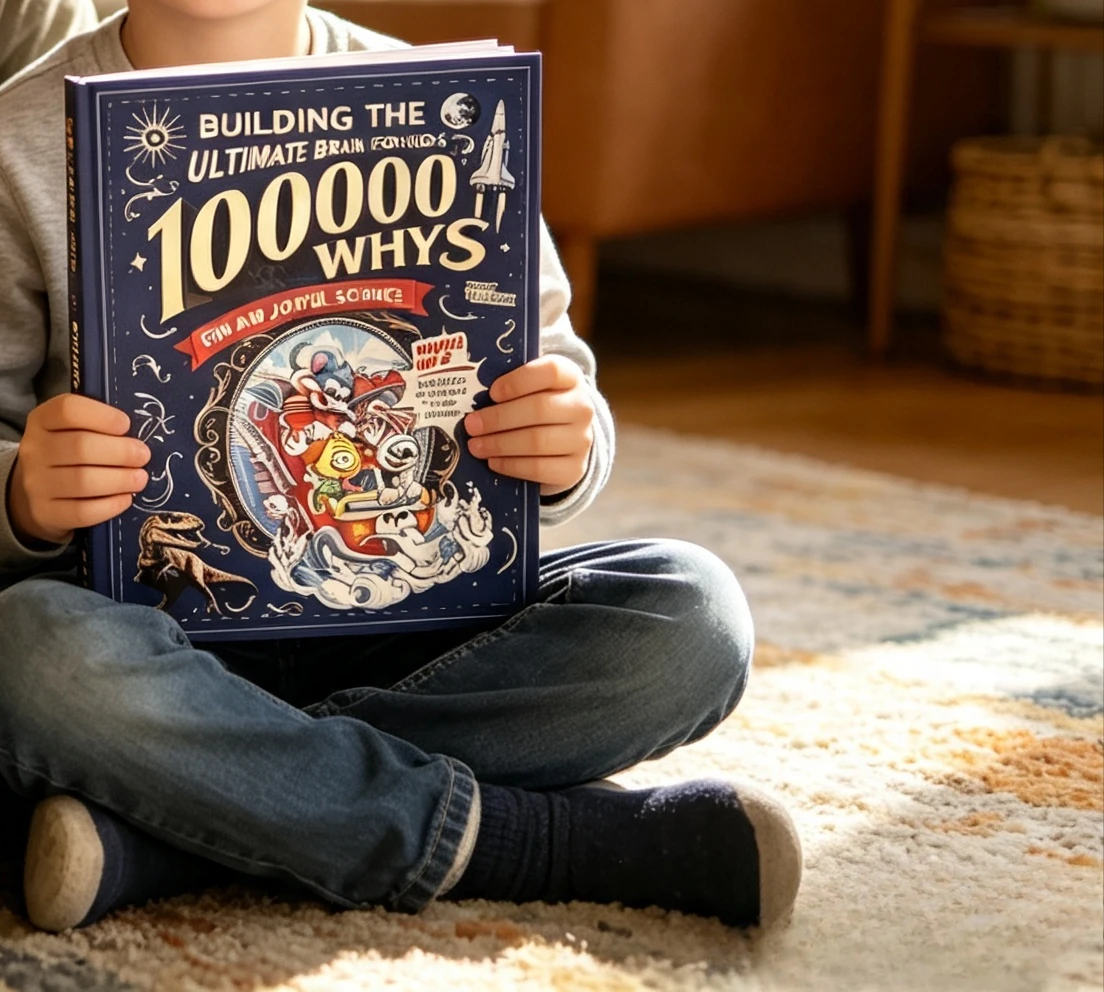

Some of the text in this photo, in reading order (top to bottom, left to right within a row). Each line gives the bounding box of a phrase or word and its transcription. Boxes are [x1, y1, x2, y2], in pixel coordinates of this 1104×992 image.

[199, 101, 426, 139] BUILDING THE
[188, 141, 309, 183] ULTIMATE
[314, 138, 364, 159] BRAIN
[147, 154, 458, 325] 100000
[313, 217, 490, 279] WHYS
